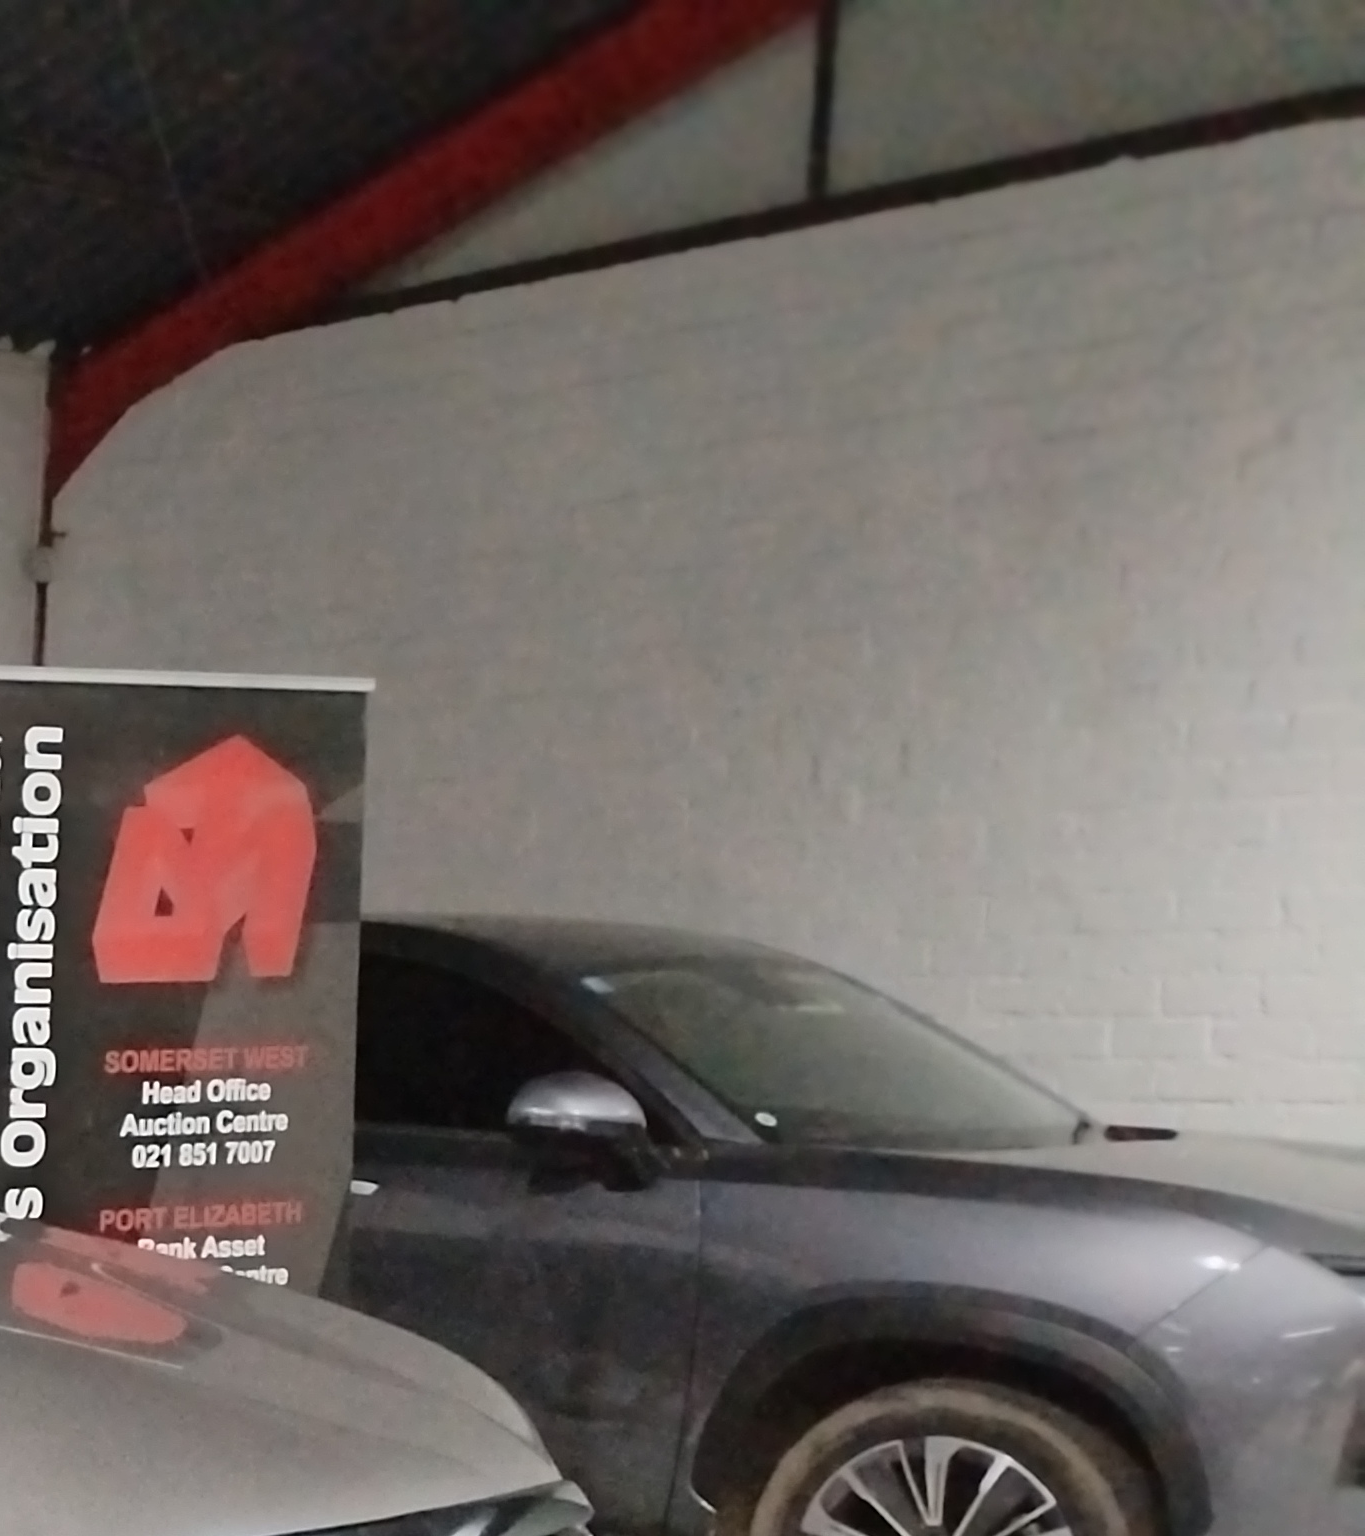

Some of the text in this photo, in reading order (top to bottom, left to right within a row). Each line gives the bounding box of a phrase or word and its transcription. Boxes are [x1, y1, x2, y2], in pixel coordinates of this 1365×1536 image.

[0, 726, 63, 1167] Organisation
[104, 1044, 310, 1075] SOMERSET WEST
[141, 1077, 272, 1105] Head Office
[119, 1109, 289, 1138] Auction Centre
[131, 1138, 277, 1169] 021 851 7007
[99, 1200, 303, 1233] PORT ELIZABETH
[200, 1234, 266, 1259] Asset
